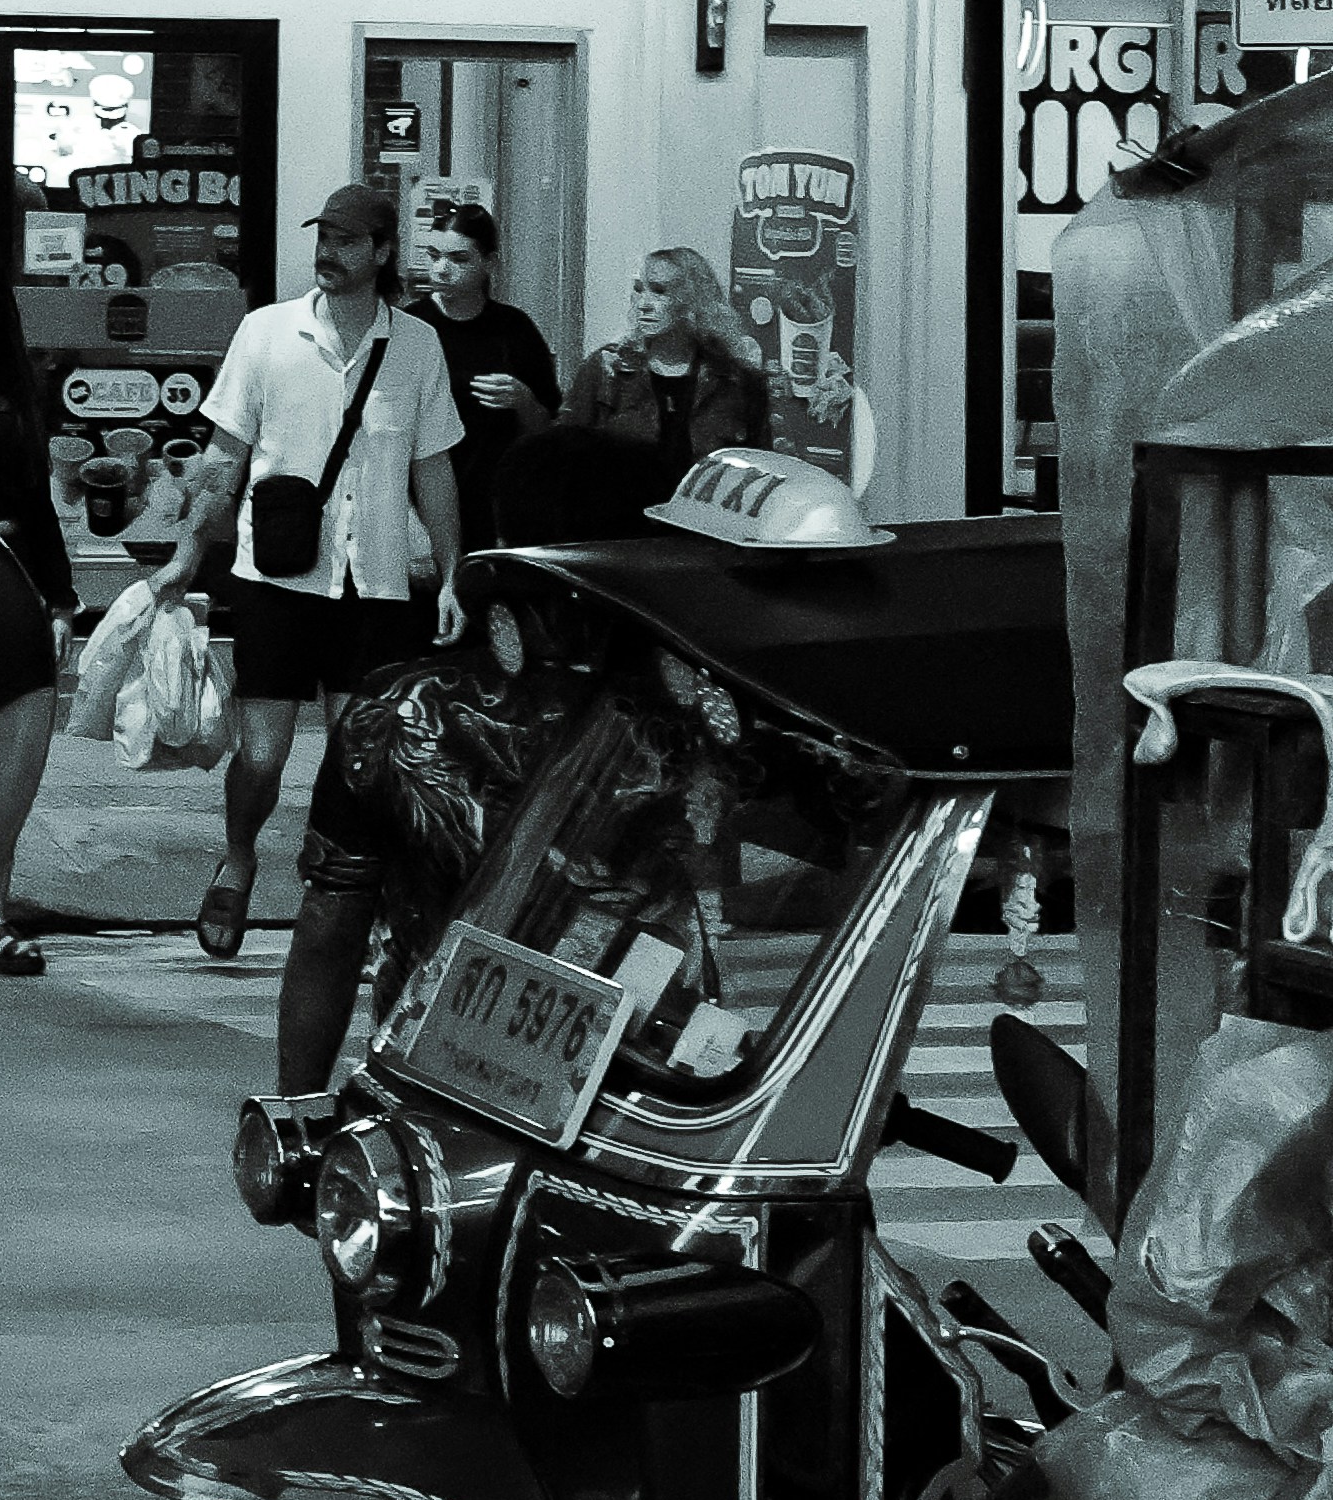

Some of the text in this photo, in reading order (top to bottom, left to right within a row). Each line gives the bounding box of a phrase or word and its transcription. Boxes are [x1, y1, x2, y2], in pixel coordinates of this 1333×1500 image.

[77, 169, 190, 208] KING
[742, 163, 848, 208] TOM YUM
[682, 457, 787, 518] TAXI
[507, 979, 595, 1062] 5976
